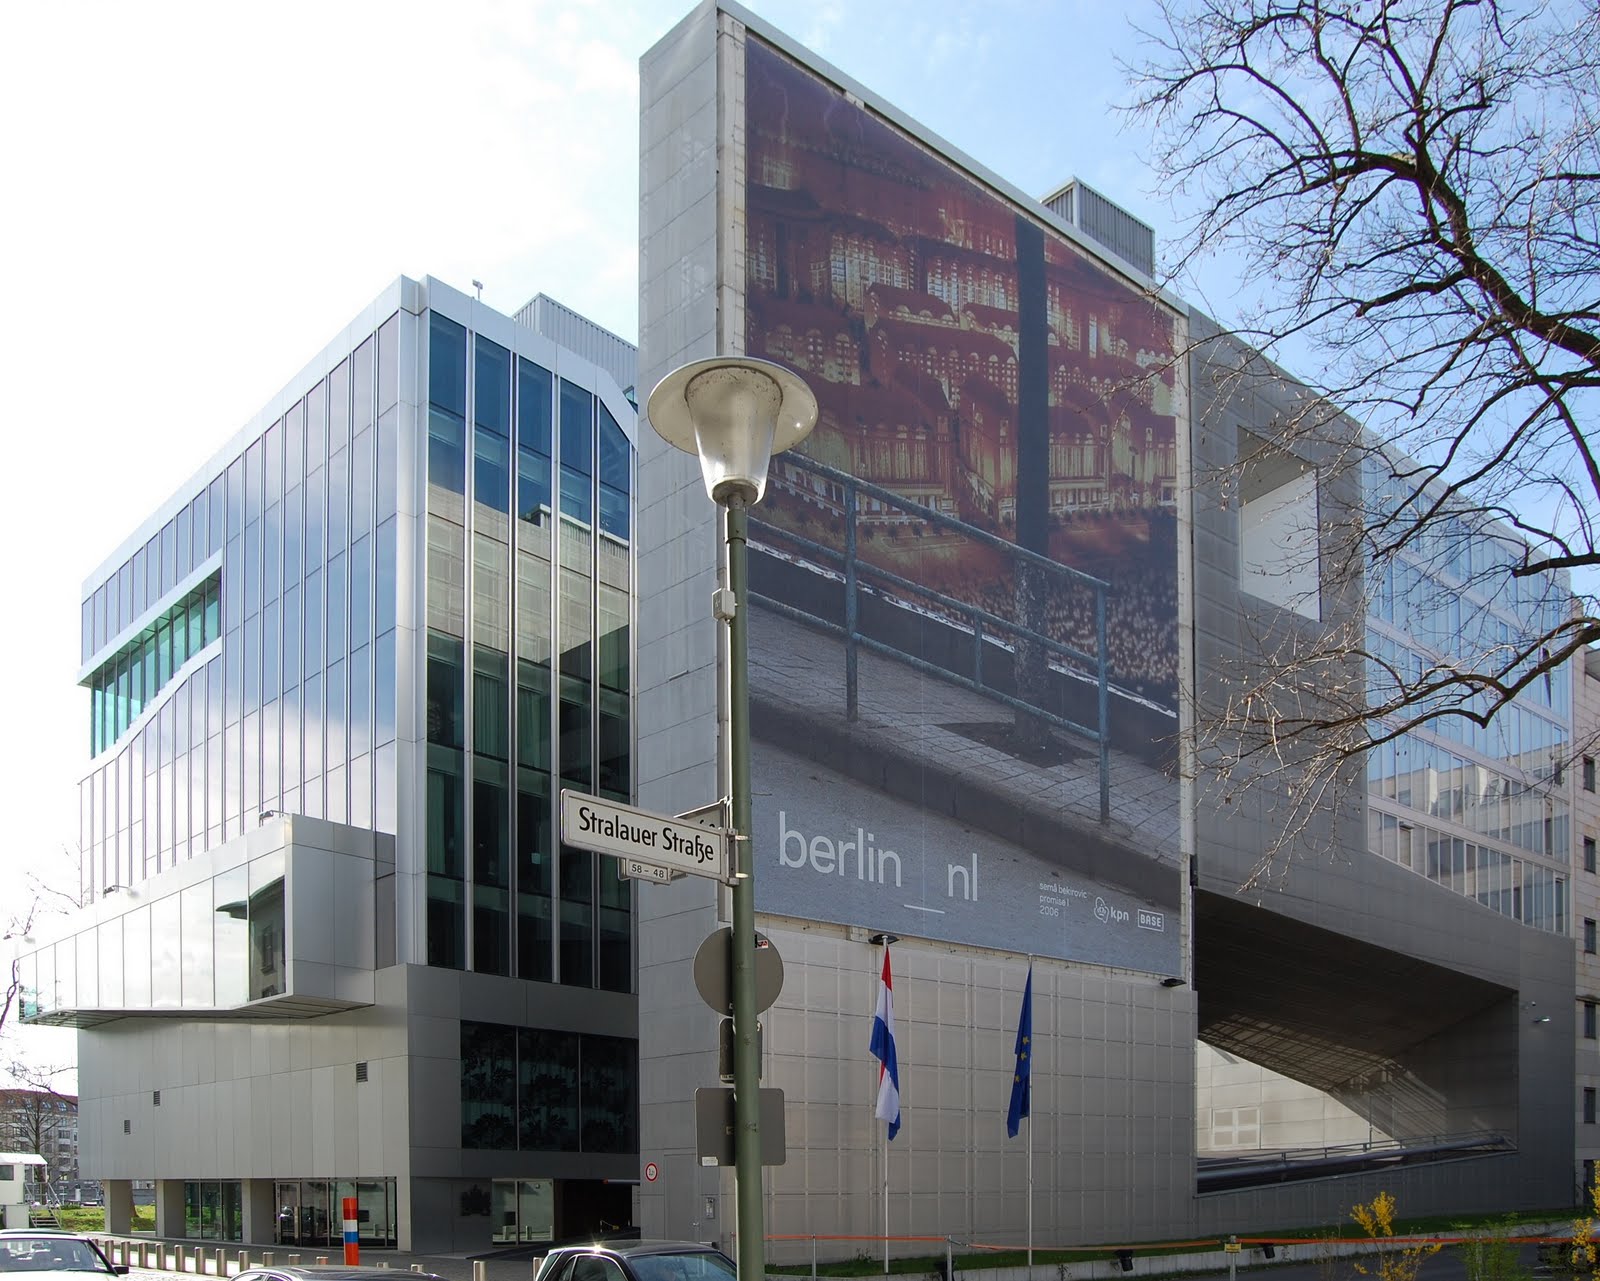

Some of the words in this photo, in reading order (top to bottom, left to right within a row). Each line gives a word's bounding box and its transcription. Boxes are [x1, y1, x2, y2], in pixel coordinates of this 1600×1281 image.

[579, 806, 658, 847] Stralauer
[662, 827, 714, 863] Straße
[631, 863, 643, 874] 58
[653, 869, 665, 879] 48
[1039, 905, 1059, 917] 2006
[1110, 906, 1129, 922] kpn
[1140, 914, 1162, 927] BASE
